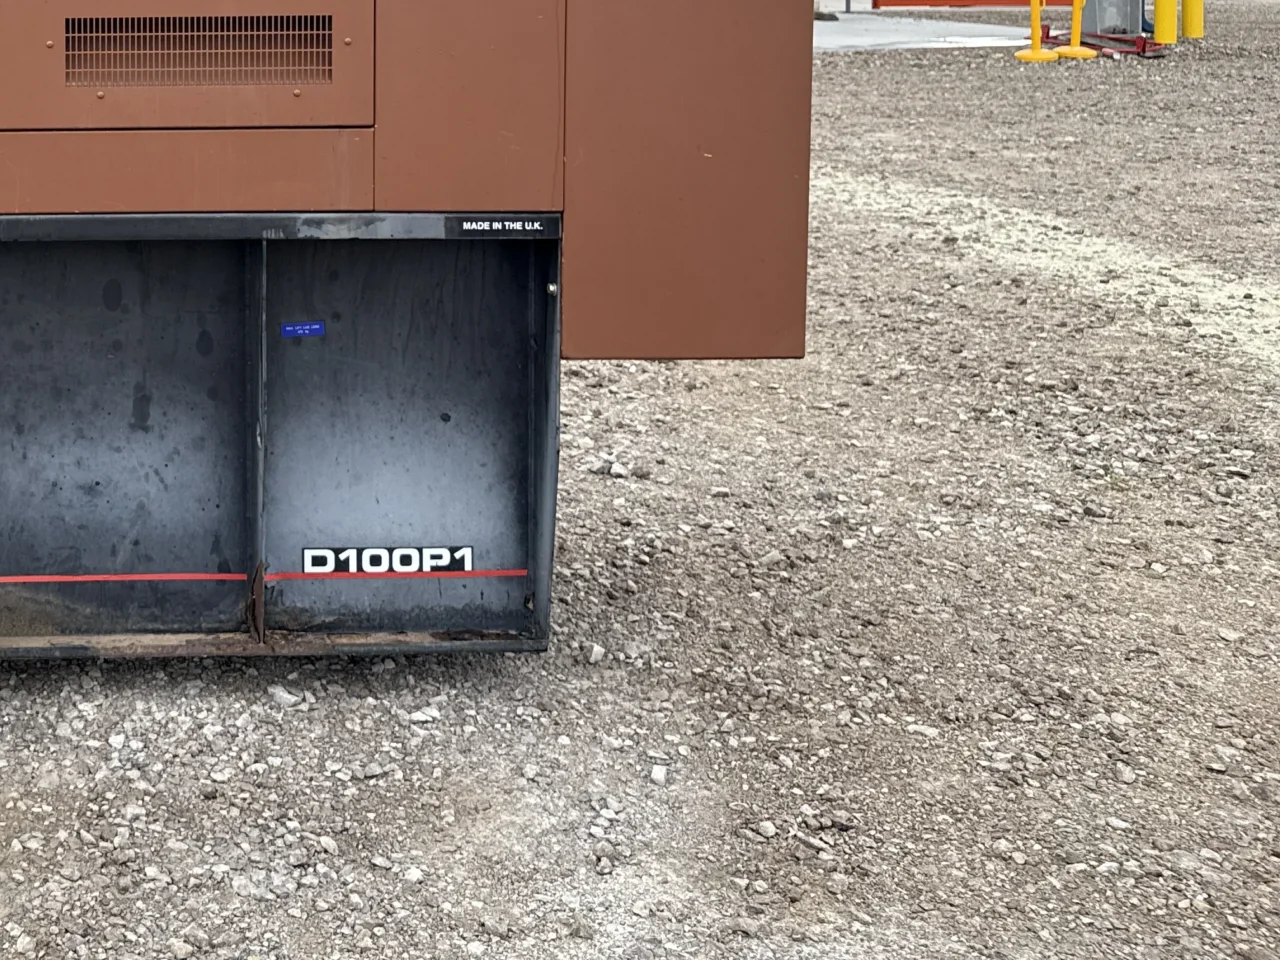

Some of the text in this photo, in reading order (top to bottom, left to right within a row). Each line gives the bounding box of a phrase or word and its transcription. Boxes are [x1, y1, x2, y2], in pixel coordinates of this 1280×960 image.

[463, 221, 543, 230] MADE IN THE U.K.
[304, 547, 472, 574] D100P1
